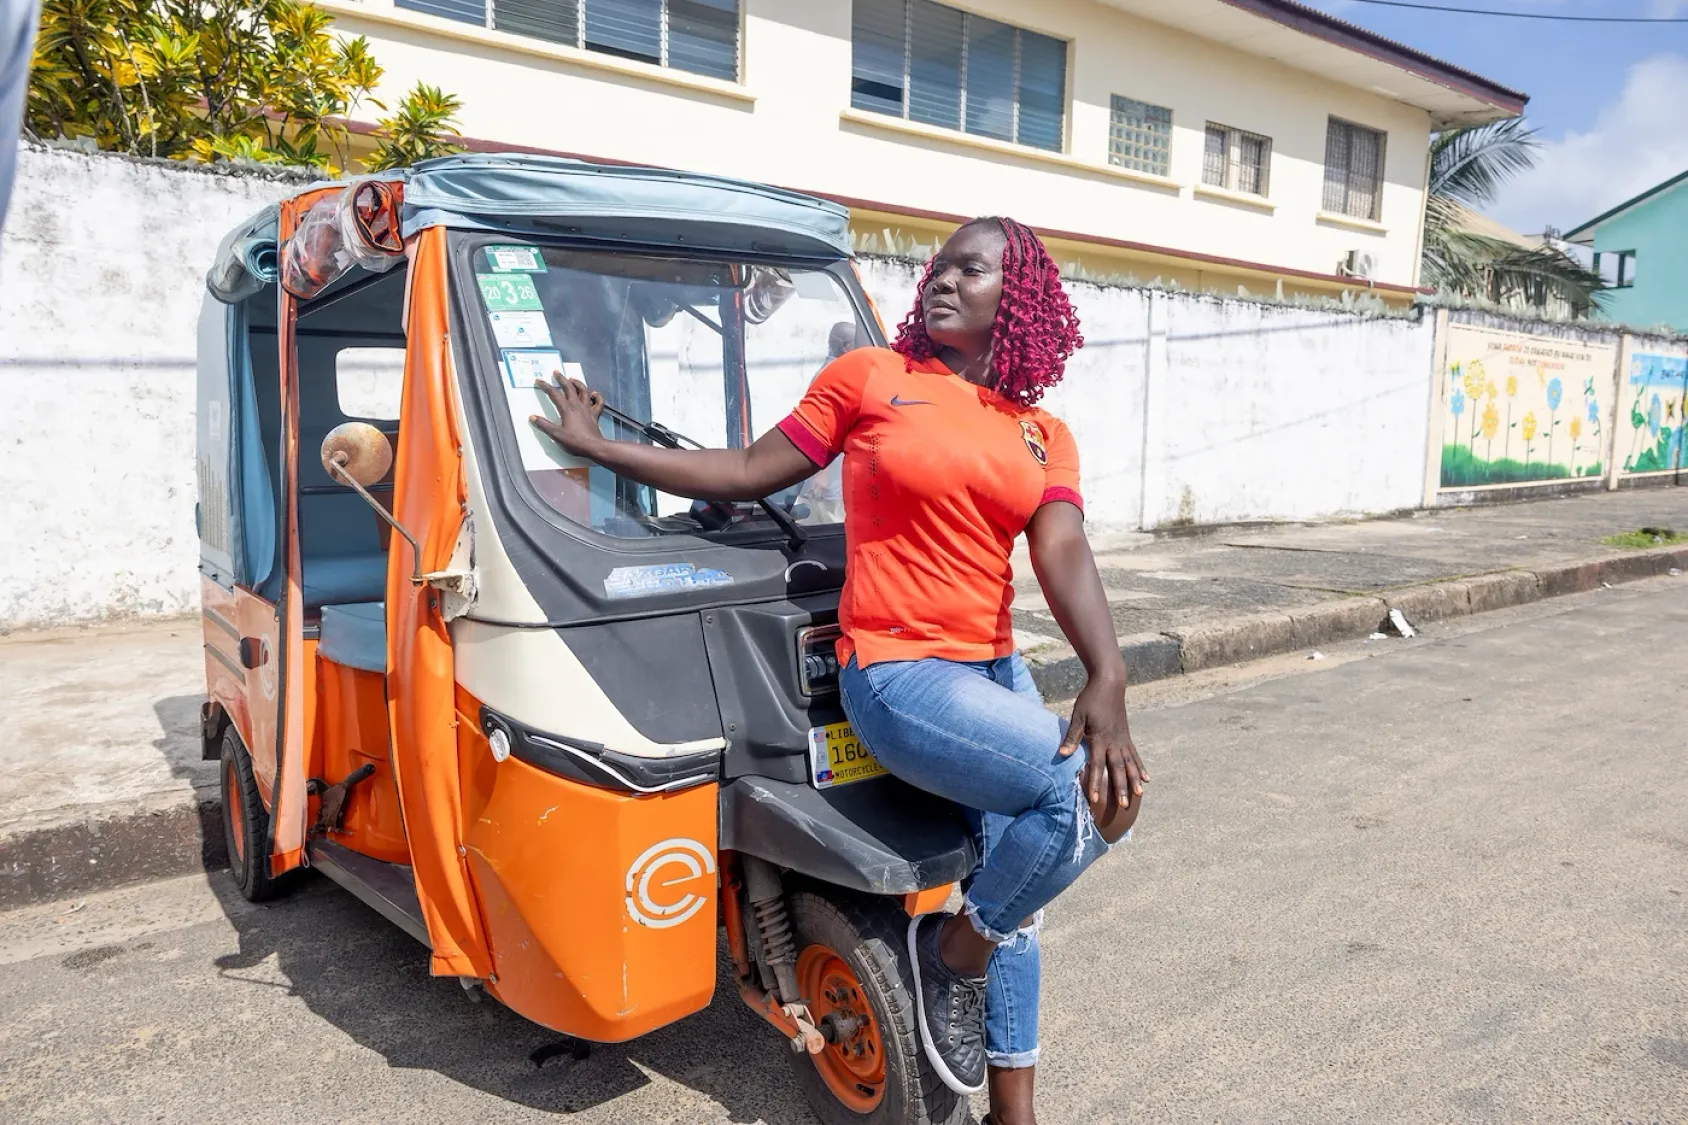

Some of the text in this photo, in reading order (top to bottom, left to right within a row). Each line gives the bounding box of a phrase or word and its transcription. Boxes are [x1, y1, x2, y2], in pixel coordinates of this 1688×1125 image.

[485, 281, 534, 305] 20 3 26
[830, 727, 856, 740] LIBE
[832, 742, 868, 764] 160
[835, 762, 878, 779] MOTORCYCLE
